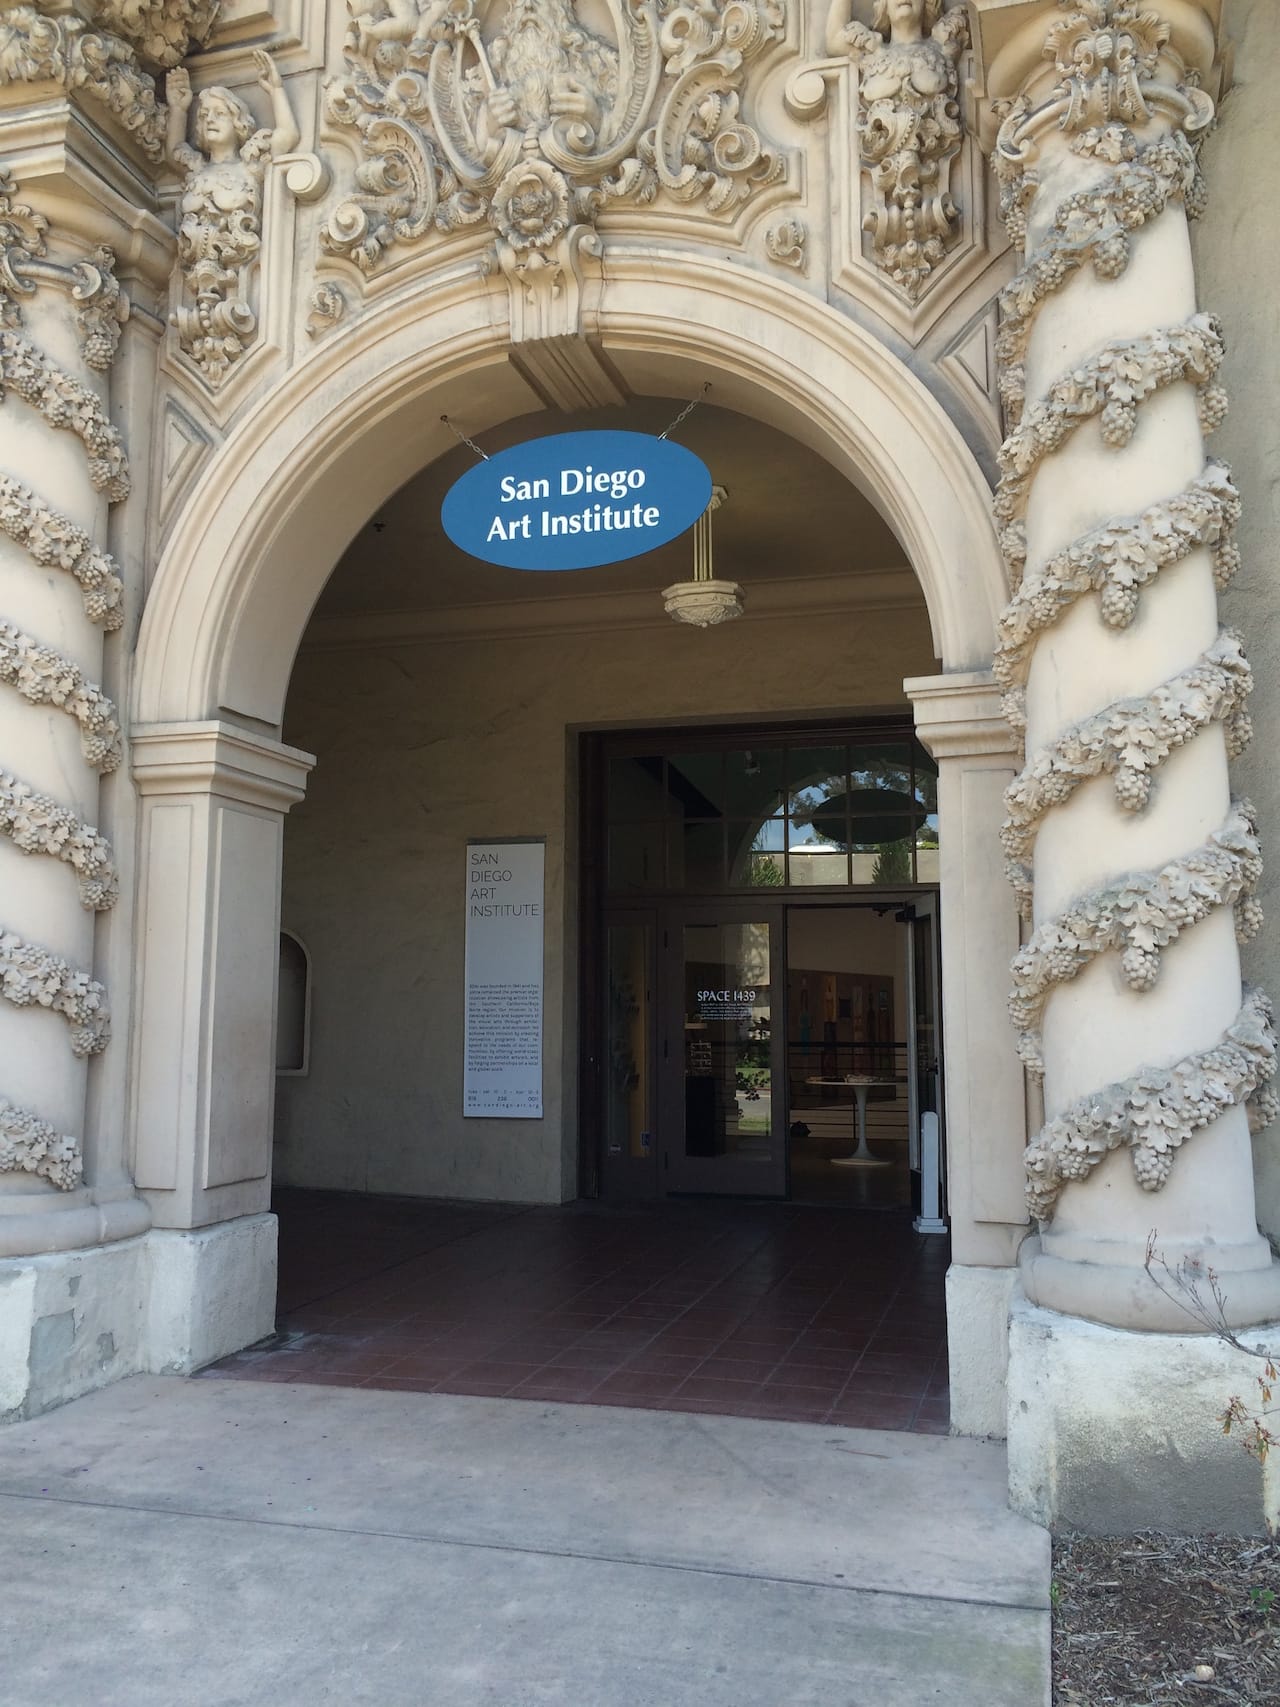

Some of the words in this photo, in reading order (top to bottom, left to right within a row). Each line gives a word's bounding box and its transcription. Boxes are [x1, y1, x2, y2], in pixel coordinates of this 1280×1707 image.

[500, 476, 550, 503] San
[560, 465, 646, 499] Diego
[486, 514, 531, 542] Art
[541, 503, 660, 536] Institute
[471, 853, 499, 865] SAN
[471, 870, 513, 883] DIEGO
[470, 887, 497, 900] ART
[470, 903, 540, 917] INSTITUTE
[697, 990, 730, 1002] SPACE
[733, 990, 755, 1002] 1439
